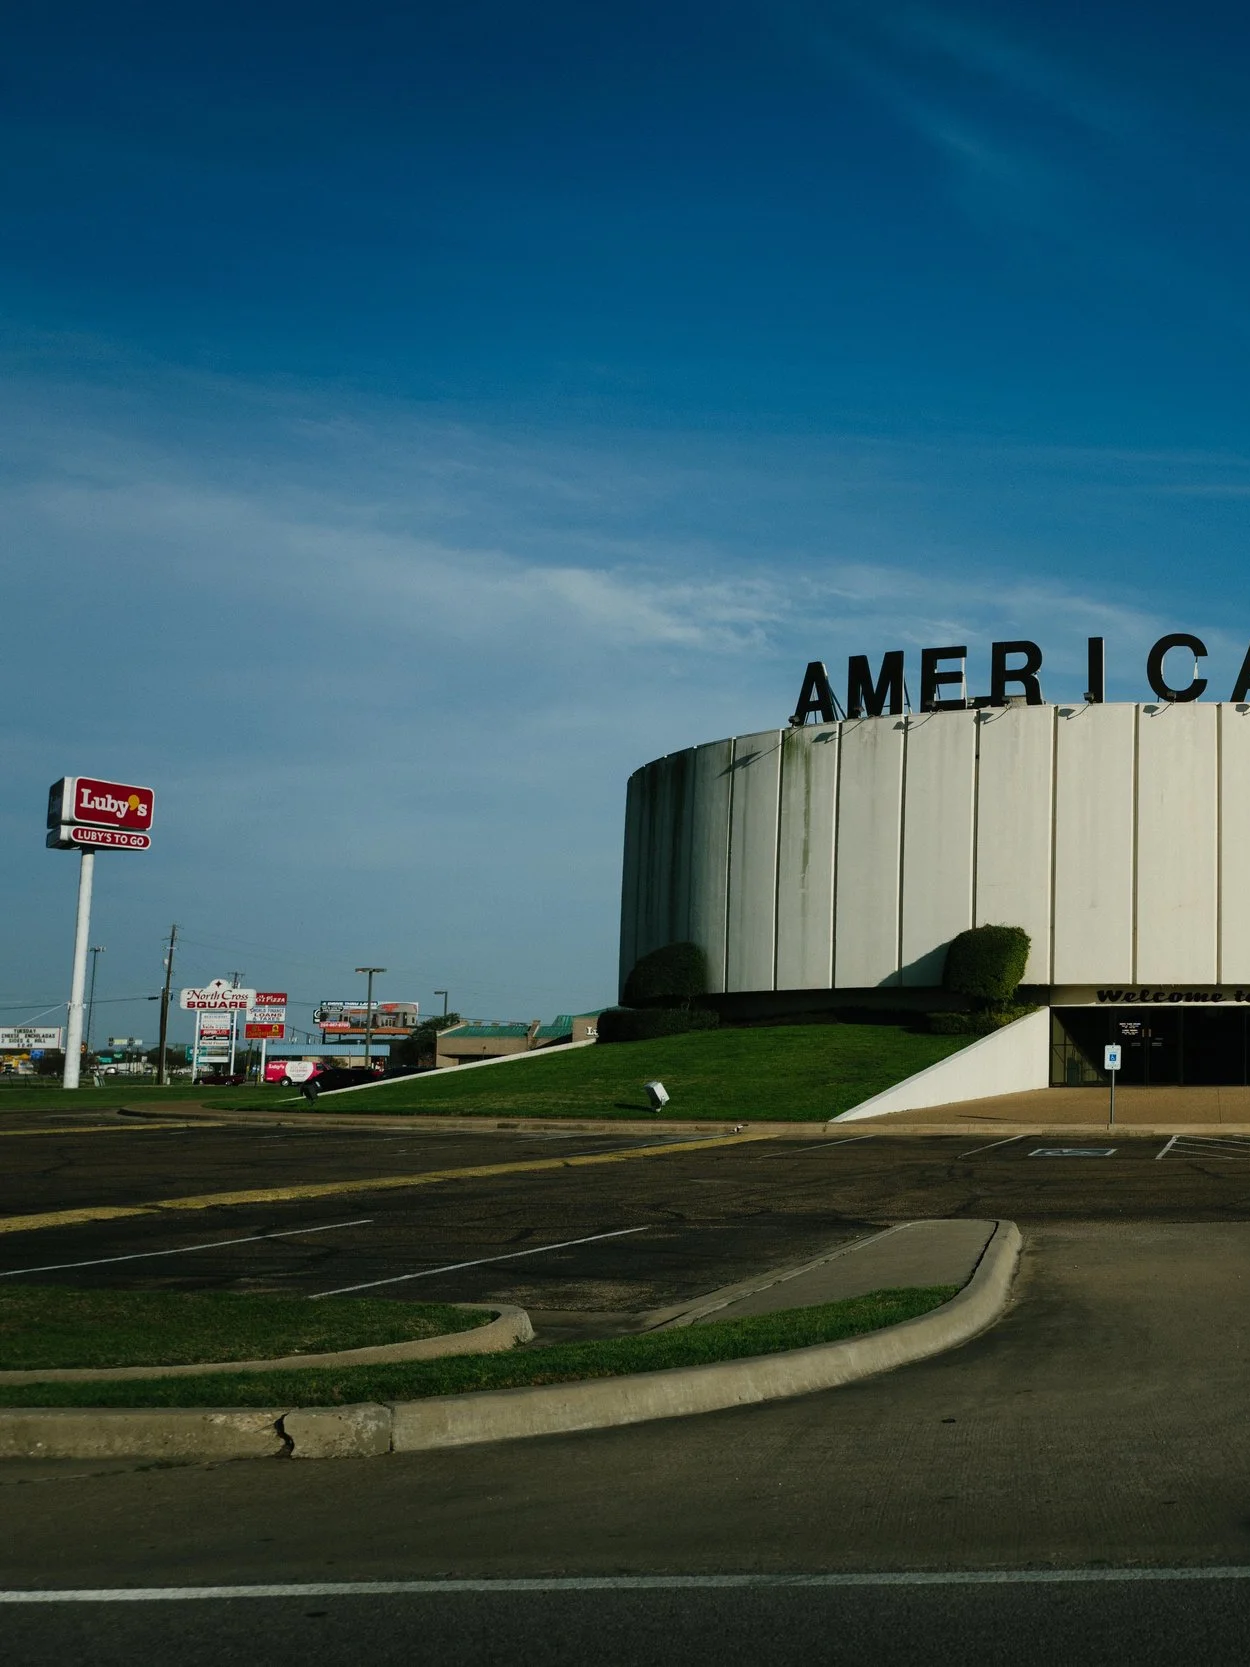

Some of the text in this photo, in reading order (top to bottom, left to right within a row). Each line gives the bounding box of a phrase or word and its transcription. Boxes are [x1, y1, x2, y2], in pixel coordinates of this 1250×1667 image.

[80, 788, 147, 818] Luby's
[78, 830, 144, 846] LUBY'S TO GO
[187, 989, 249, 1001] North Cross
[1096, 989, 1226, 1003] Welcome
[186, 1001, 247, 1009] SQUARE
